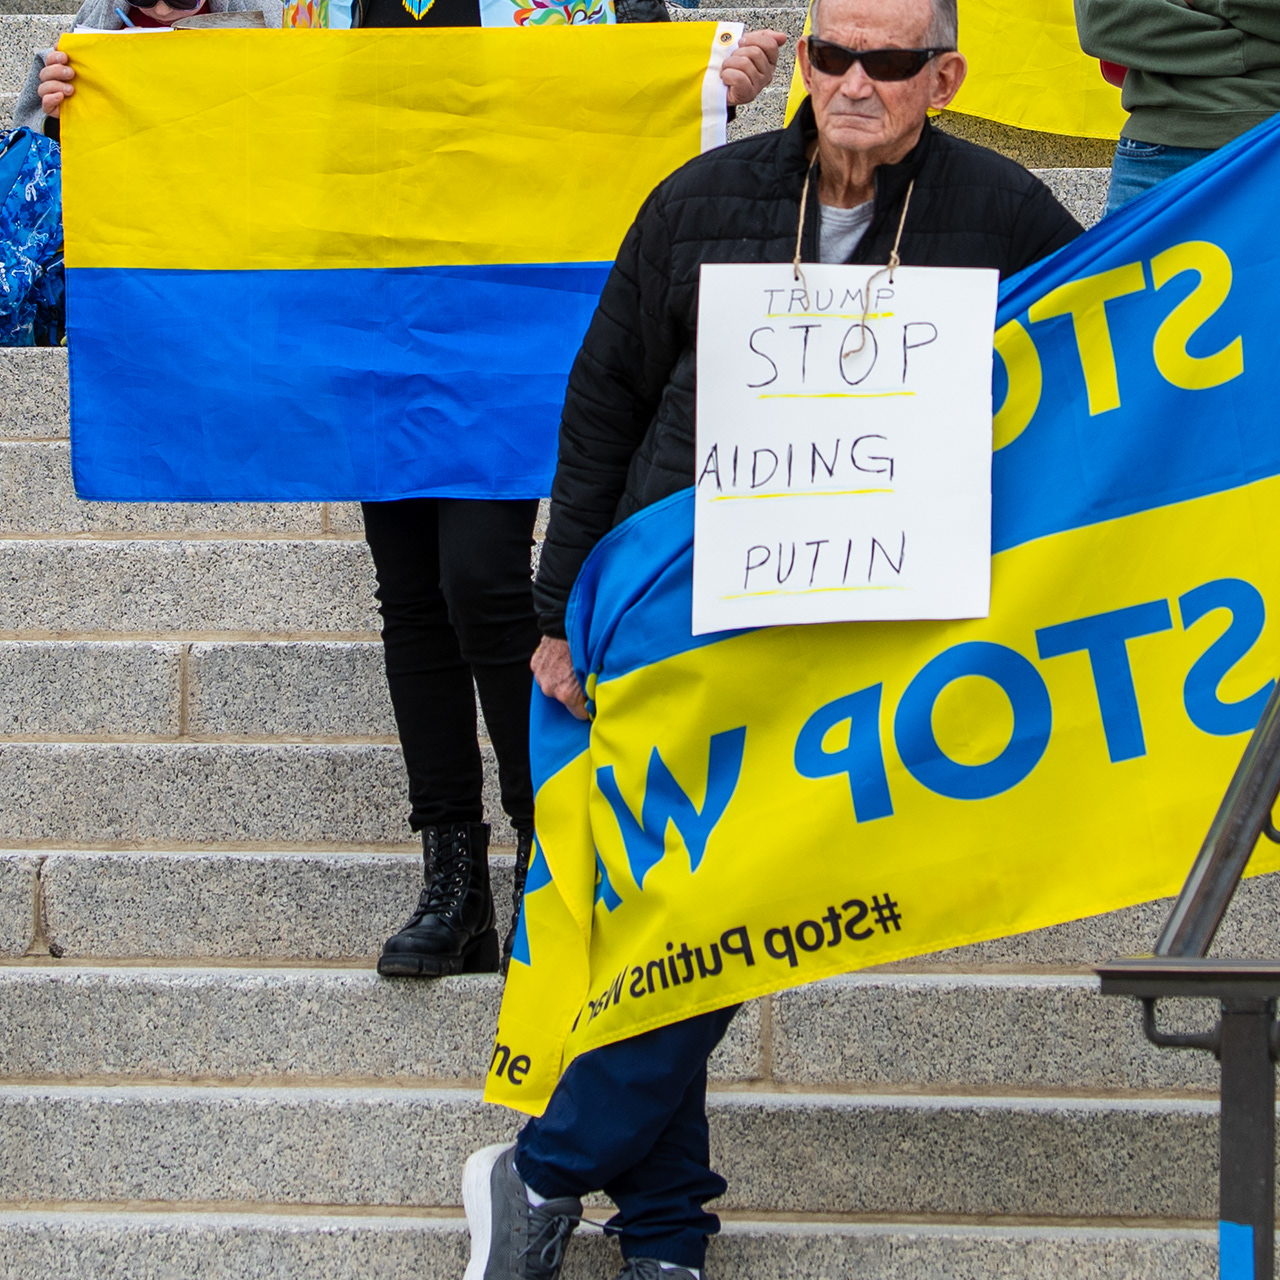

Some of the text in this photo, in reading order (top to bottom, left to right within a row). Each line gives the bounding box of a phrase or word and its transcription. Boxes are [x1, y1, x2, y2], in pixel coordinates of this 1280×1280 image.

[764, 288, 895, 315] TRUMP
[746, 321, 938, 388] STOP
[697, 434, 895, 492] AIDING
[743, 530, 906, 589] PUTIN
